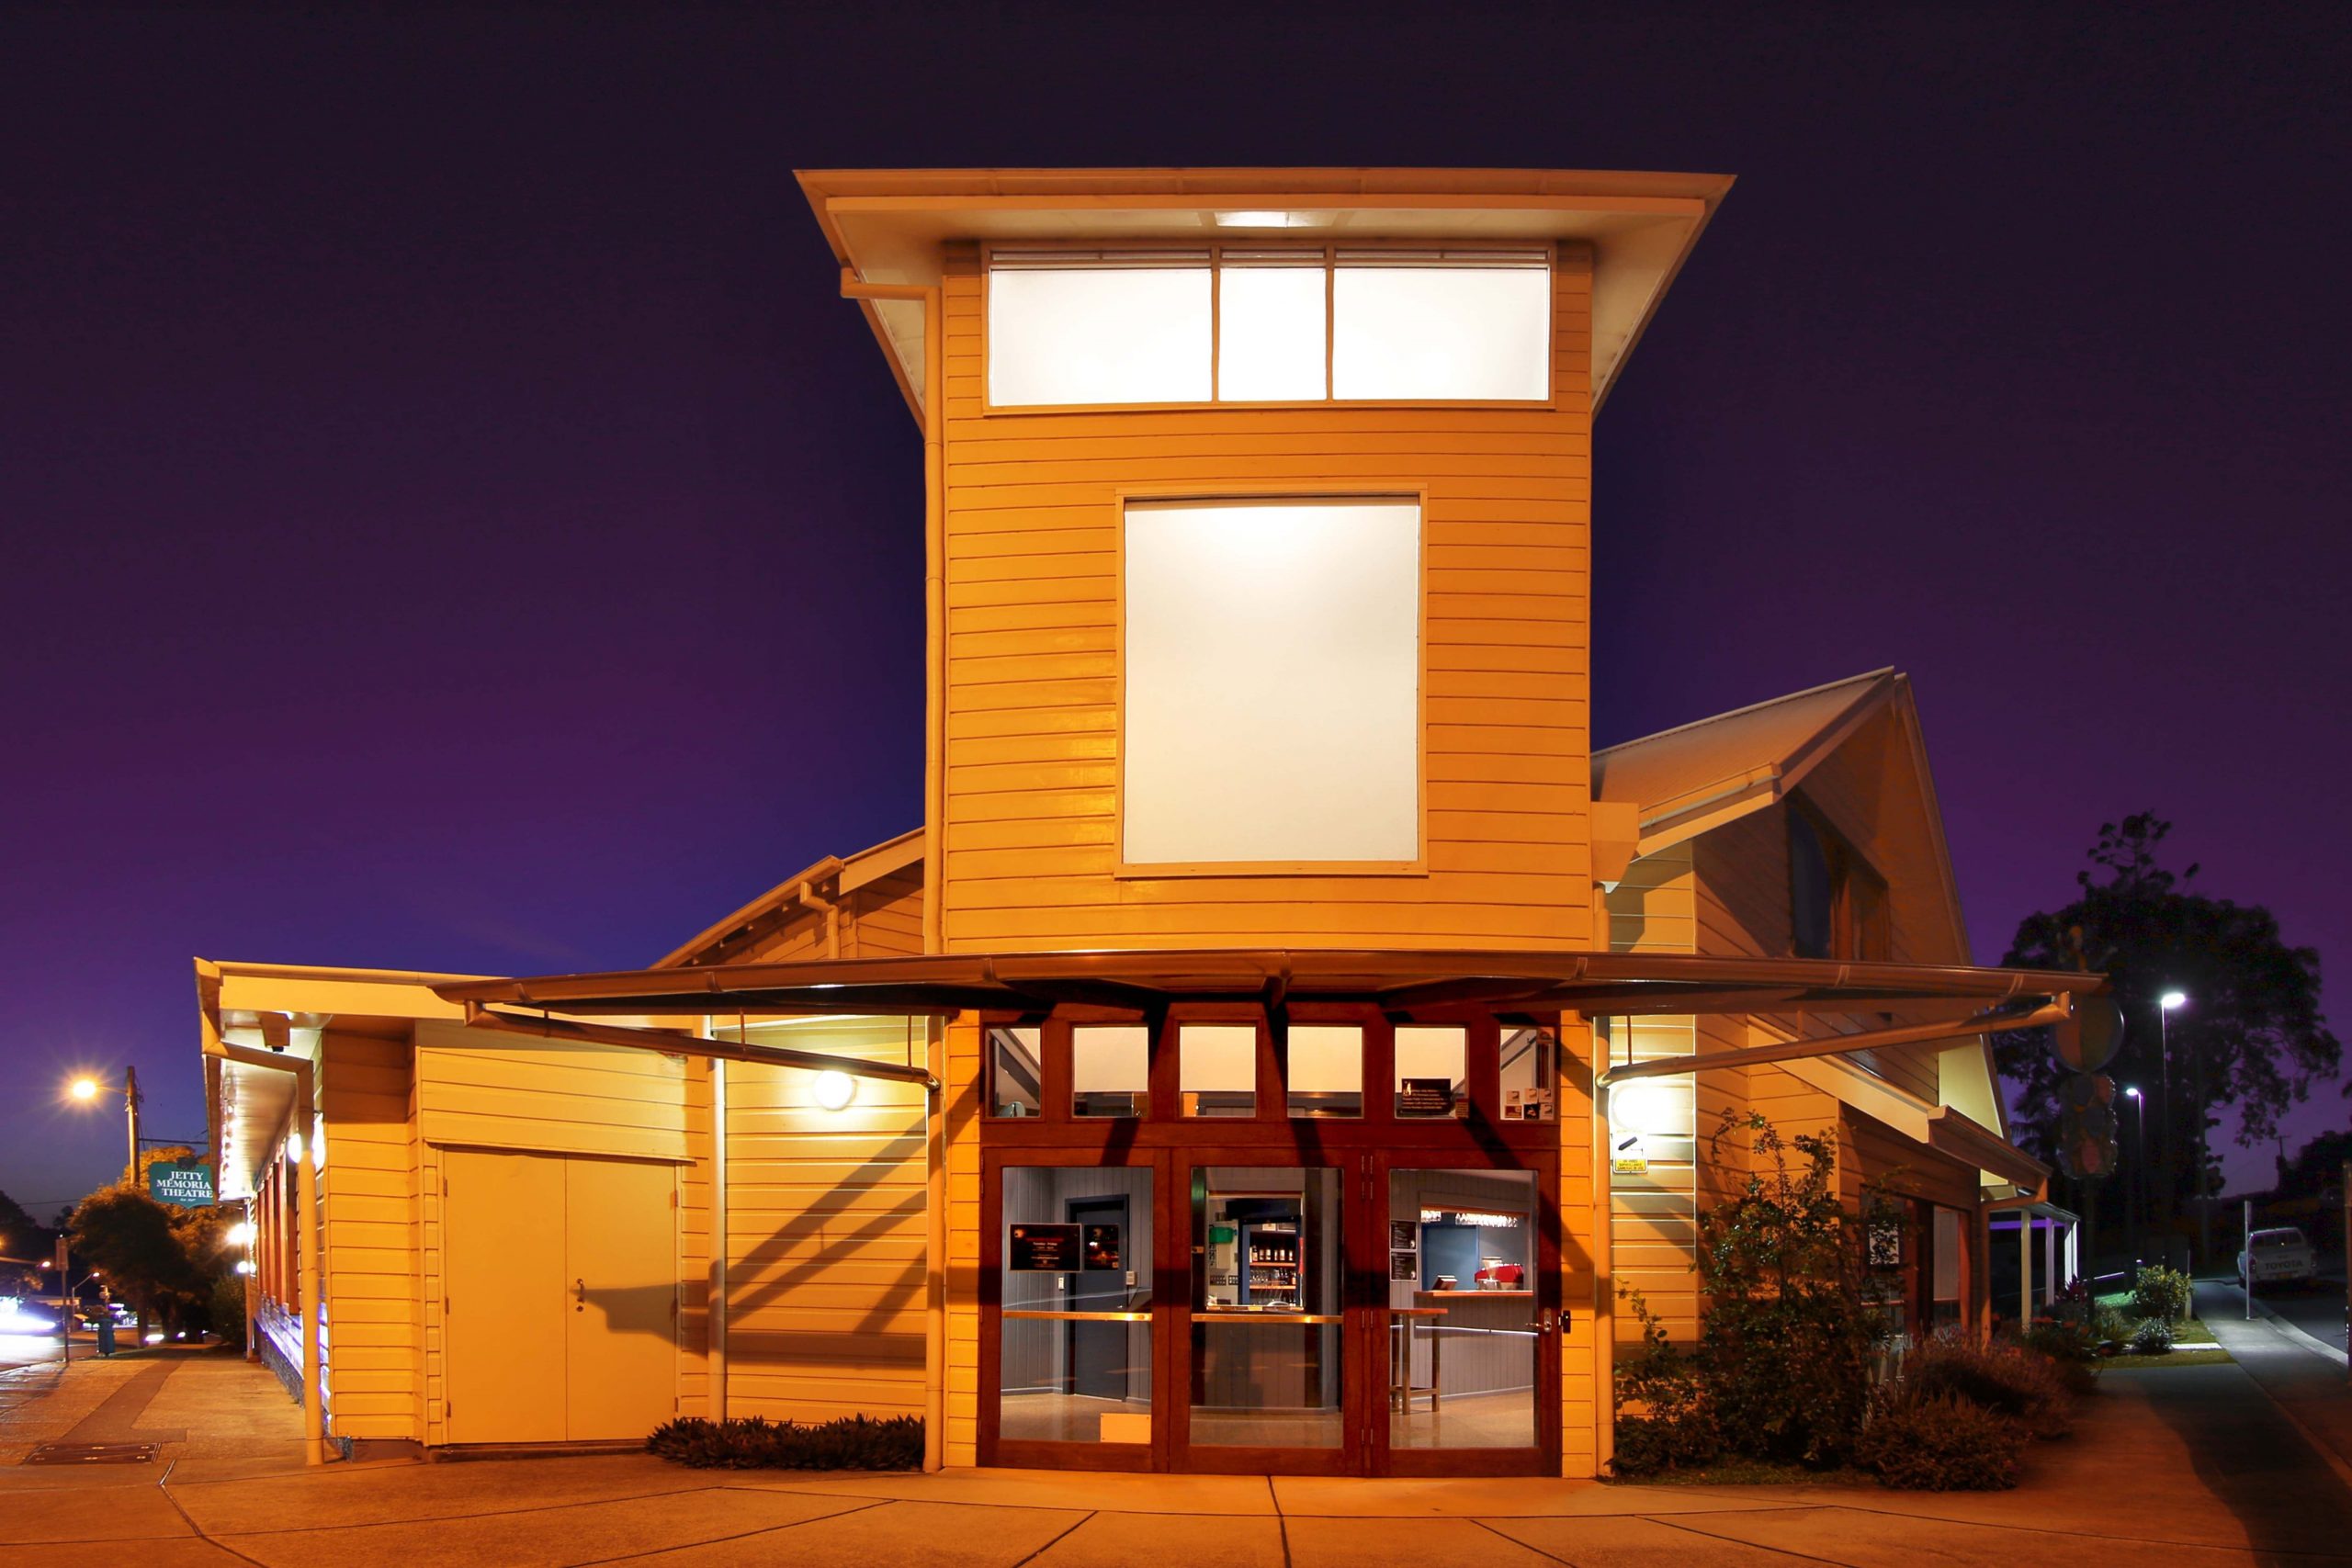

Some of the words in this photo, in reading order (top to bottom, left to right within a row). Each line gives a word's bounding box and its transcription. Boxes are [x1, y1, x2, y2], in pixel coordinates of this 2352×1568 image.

[169, 1171, 203, 1180] JETTY
[156, 1179, 212, 1190] MEMORIA
[162, 1188, 213, 1198] THEATRE
[2265, 1259, 2303, 1269] TOYOTA
